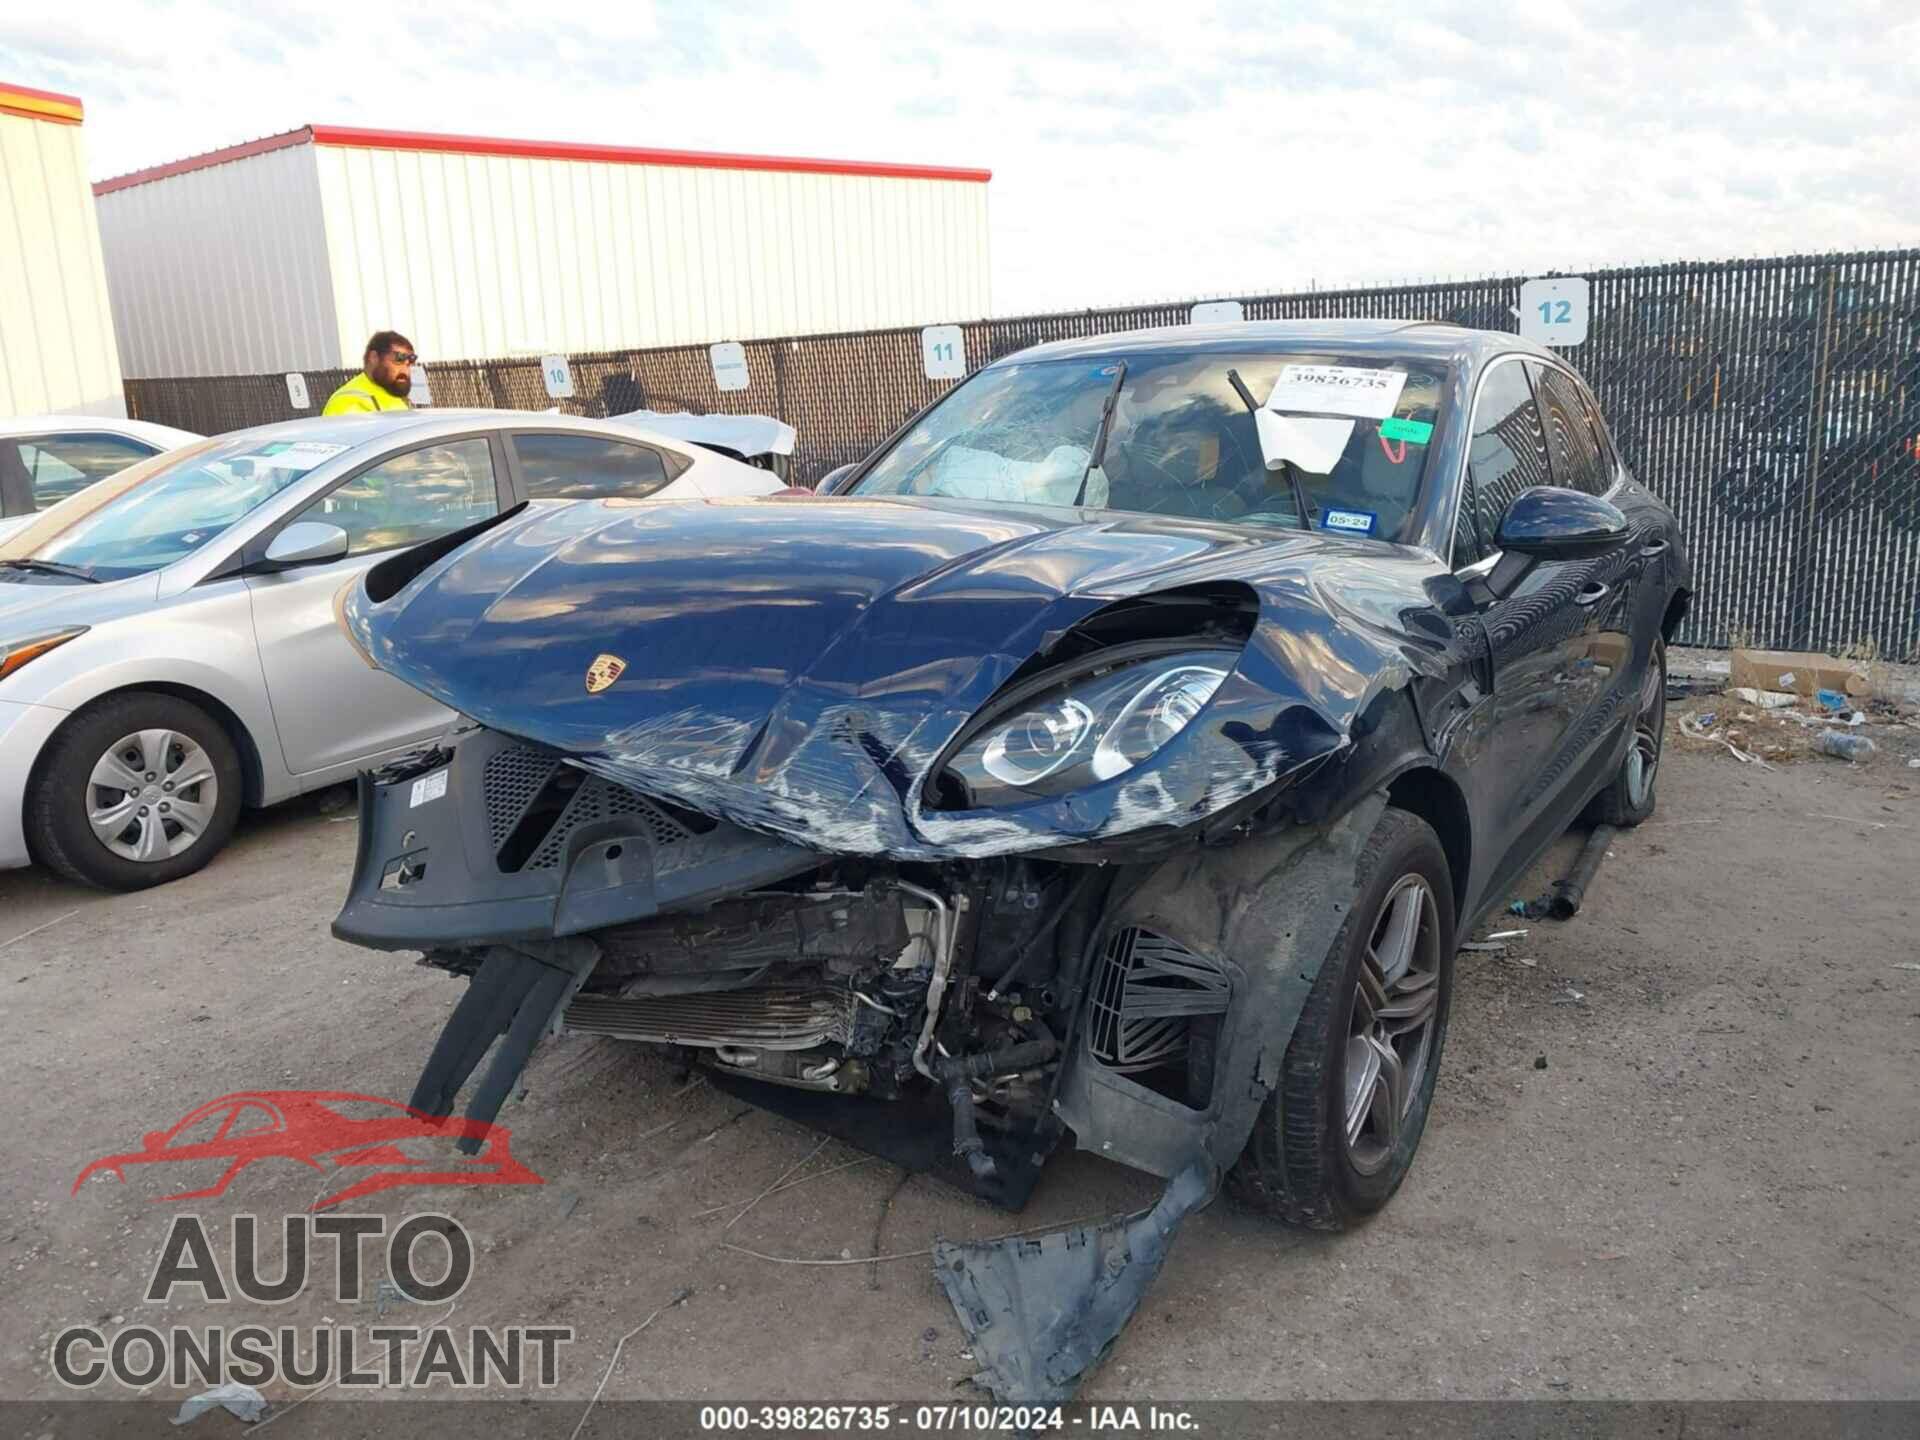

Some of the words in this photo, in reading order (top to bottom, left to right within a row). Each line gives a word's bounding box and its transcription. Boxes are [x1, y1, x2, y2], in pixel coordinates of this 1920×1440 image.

[1537, 300, 1571, 324] 12
[933, 342, 953, 361] 11
[550, 368, 565, 384] 10
